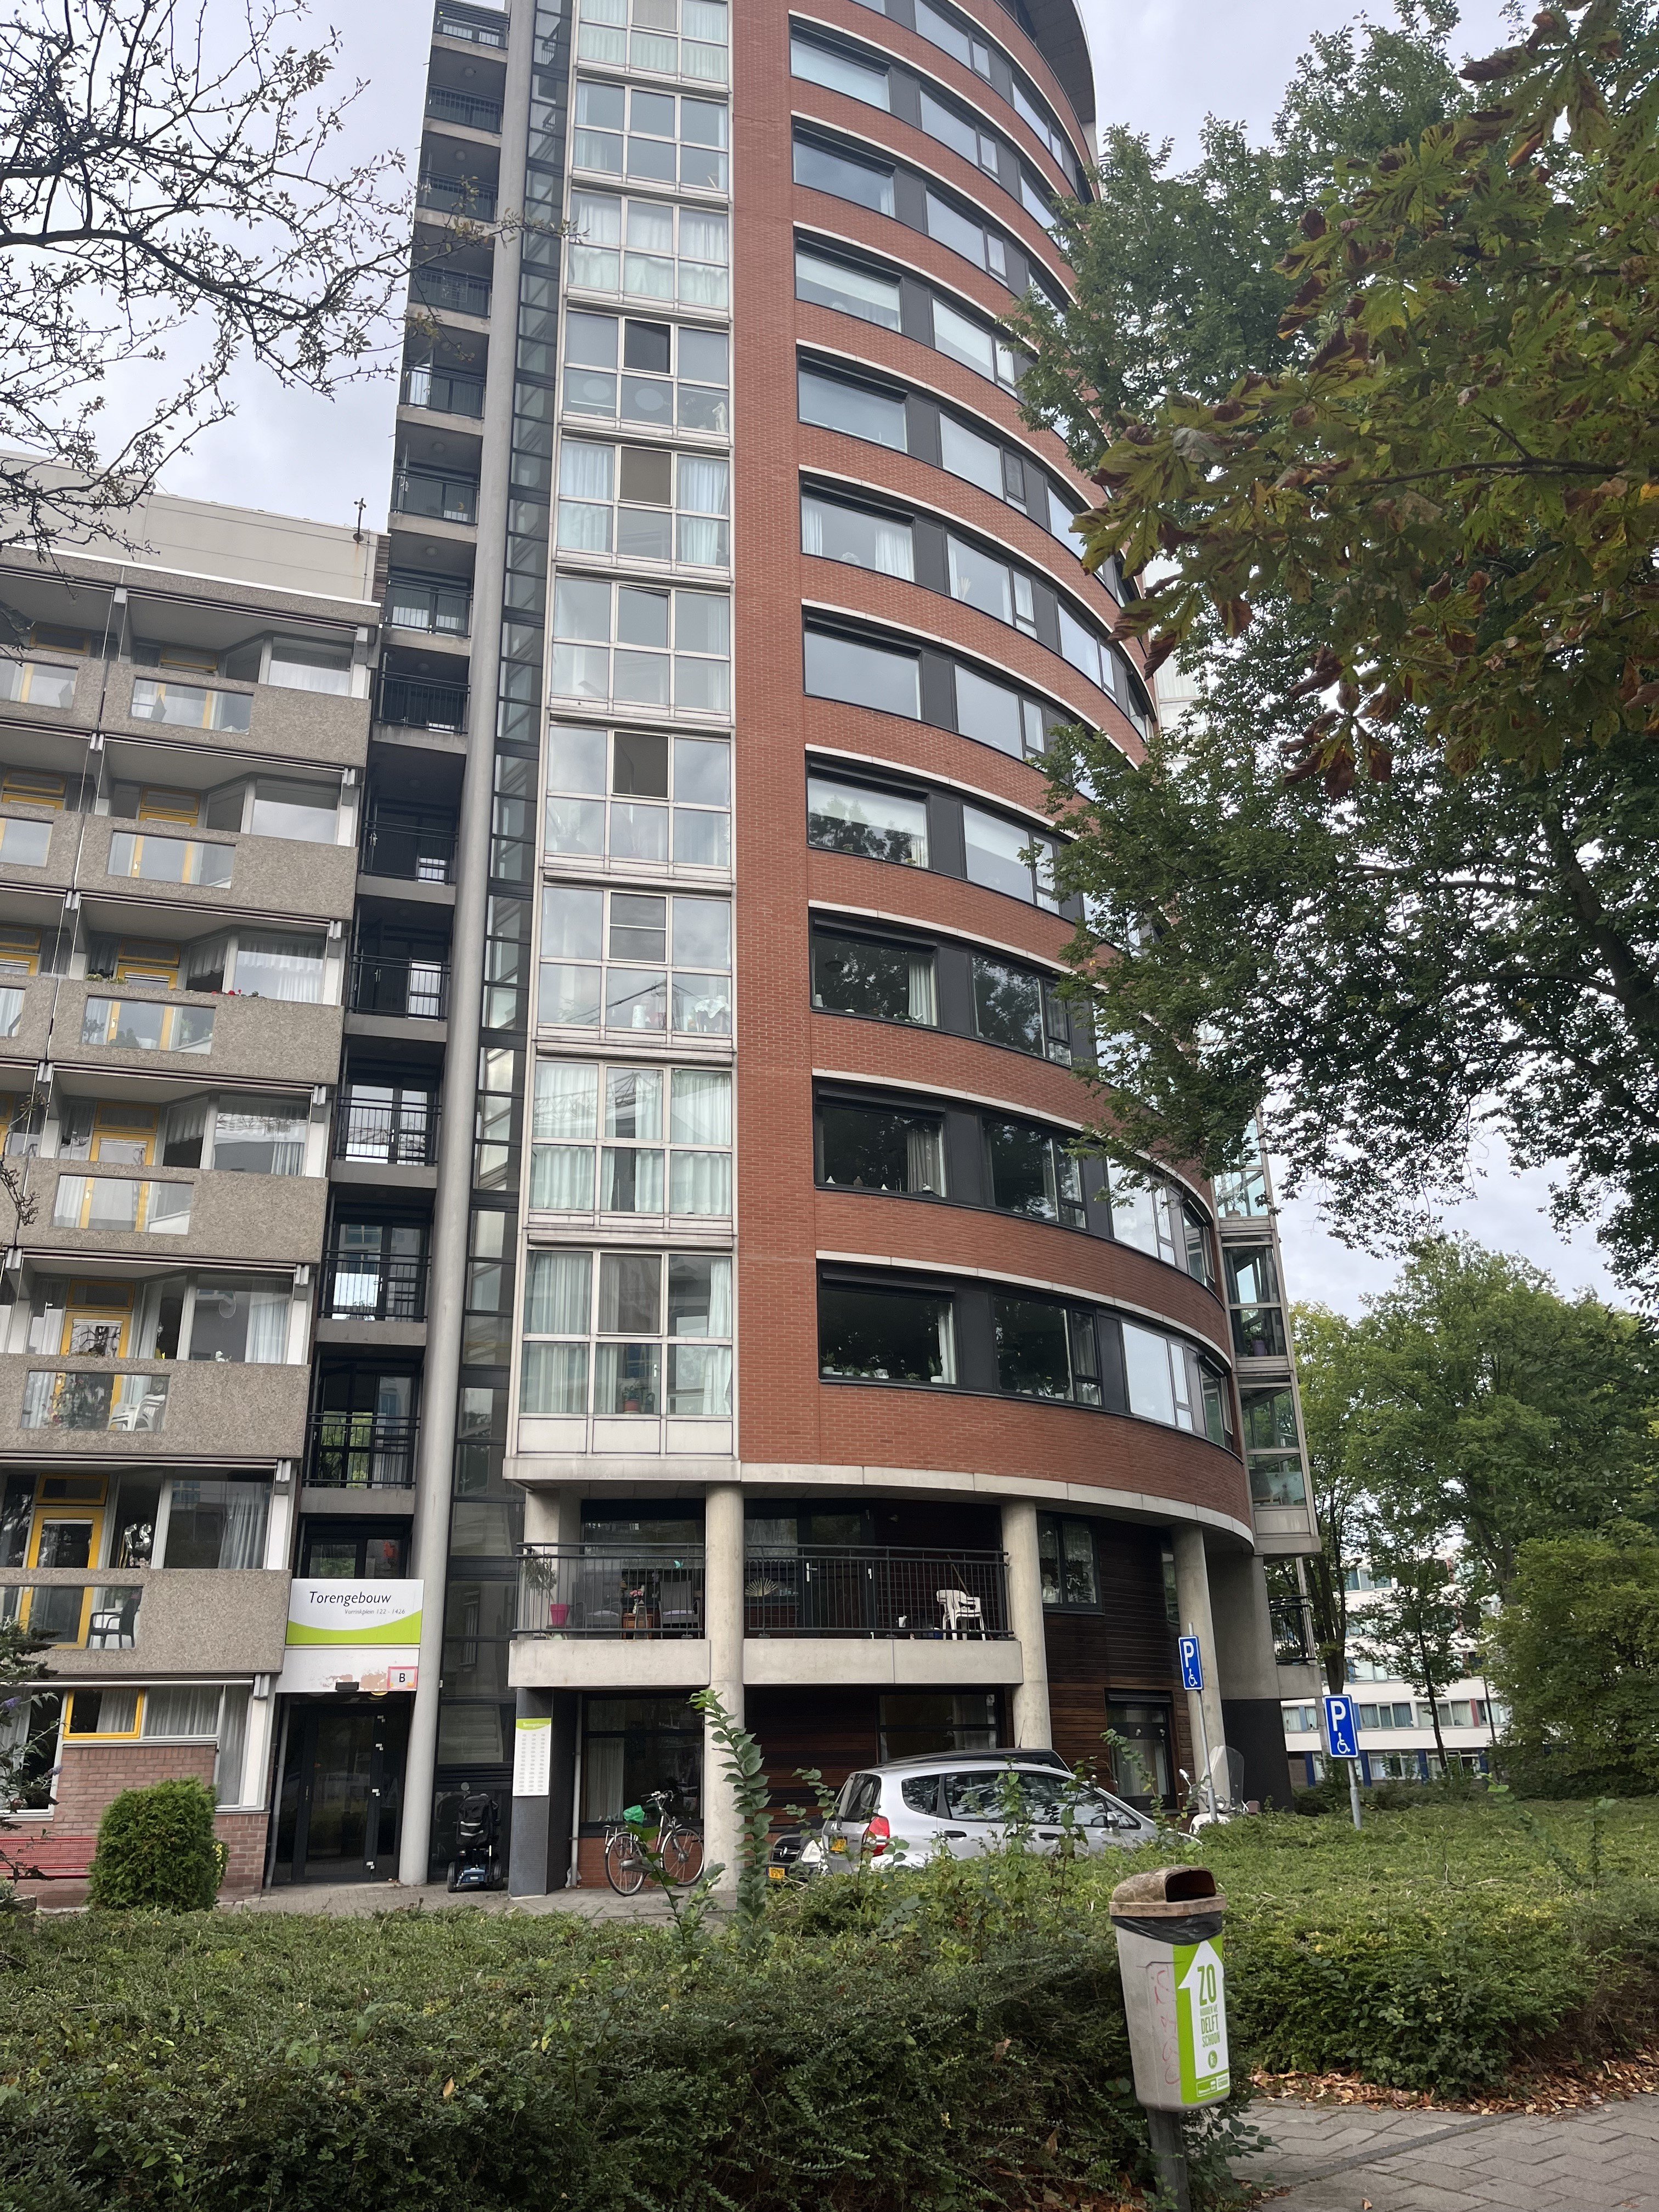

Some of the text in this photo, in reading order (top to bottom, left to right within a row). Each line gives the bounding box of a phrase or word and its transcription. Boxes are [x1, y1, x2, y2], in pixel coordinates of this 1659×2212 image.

[309, 1591, 391, 1607] Torengebouw
[1183, 1641, 1194, 1668] P
[399, 1673, 405, 1683] B
[1330, 1700, 1346, 1732] P
[1197, 1963, 1217, 2006] ZO
[1201, 2014, 1218, 2035] DELFT
